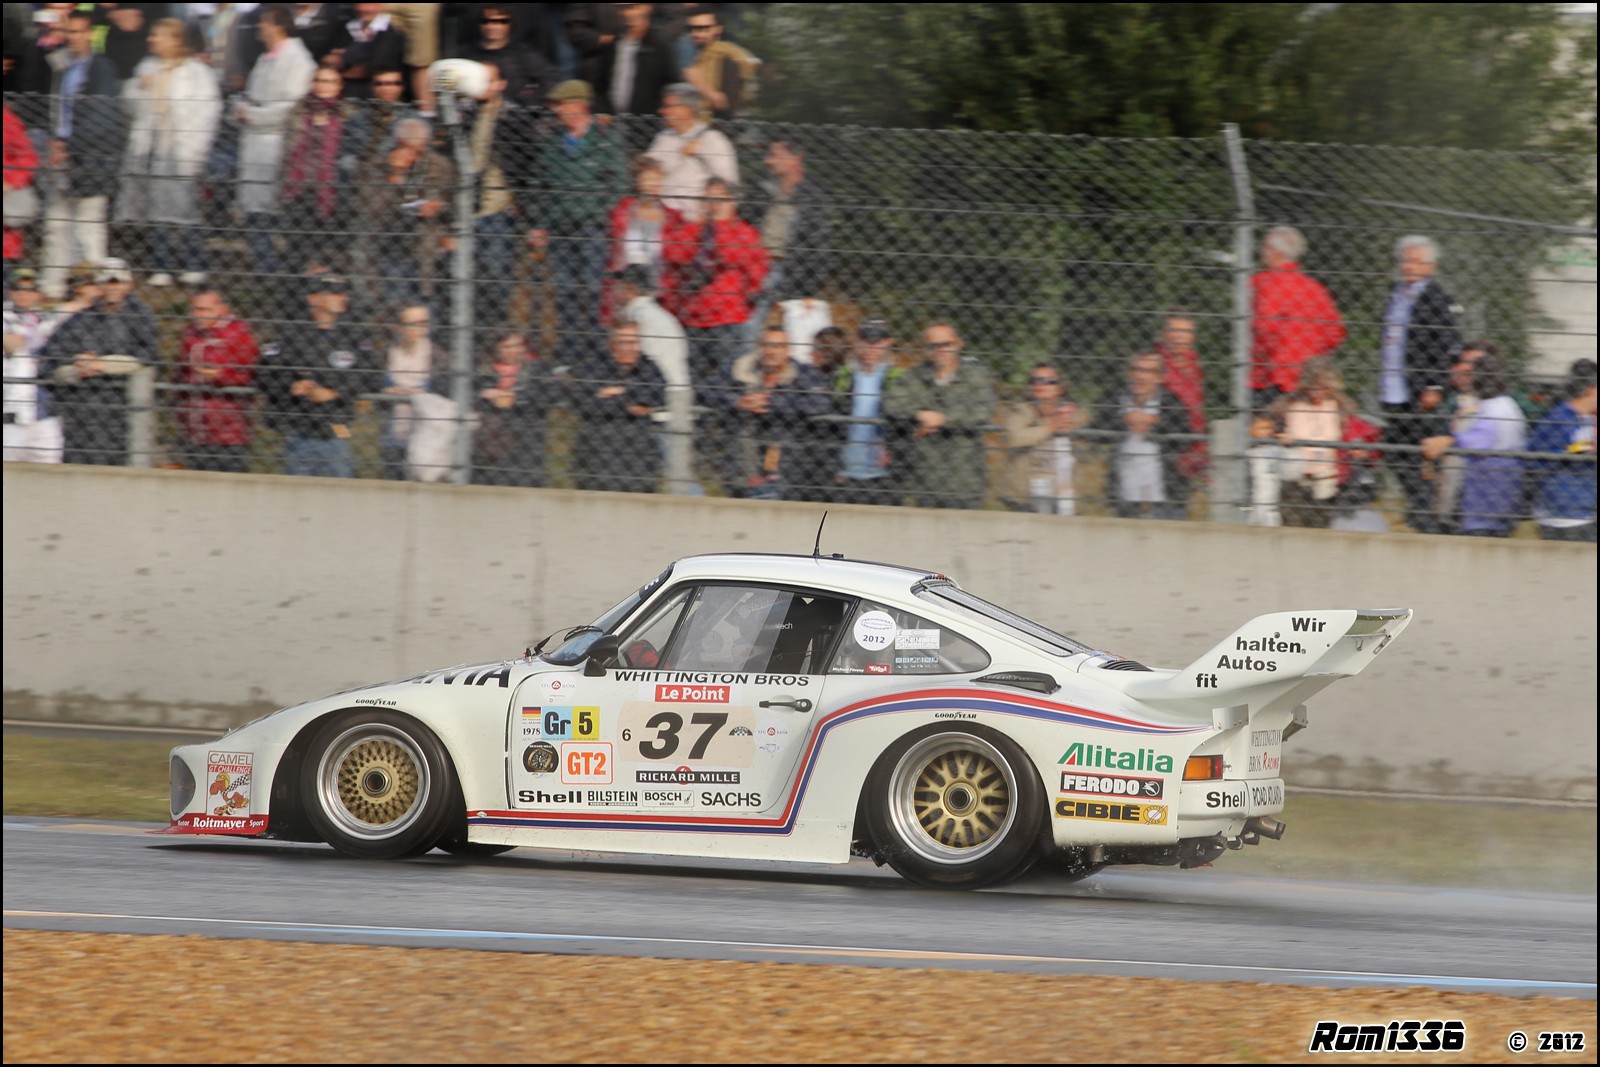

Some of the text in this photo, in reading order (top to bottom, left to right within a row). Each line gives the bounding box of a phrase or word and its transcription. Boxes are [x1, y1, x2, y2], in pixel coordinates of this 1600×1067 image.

[1291, 617, 1327, 632] Wir
[863, 634, 886, 643] 2012
[1236, 637, 1301, 653] halten
[1217, 655, 1278, 672] Autos
[614, 671, 810, 686] WHITTINGTON BROS
[1195, 673, 1218, 688] fit
[660, 687, 725, 701] Le Point
[355, 698, 397, 706] GOODYEAR
[934, 711, 977, 719] GOODYEAR
[544, 711, 593, 736] Gr 5
[522, 727, 541, 736] 1978
[621, 711, 729, 760] 6 37
[209, 753, 251, 766] CAMEL
[567, 752, 607, 776] GT2
[1057, 742, 1174, 773] Alitalia
[208, 764, 251, 775] GT CHALLENGE
[639, 772, 739, 783] RICHARD MILLE
[1063, 774, 1140, 796] FERODO
[518, 790, 582, 803] Shell
[587, 790, 638, 802] BILSTEIN
[644, 792, 682, 801] BOSCH
[701, 791, 761, 807] SACHS
[1206, 790, 1246, 809] Shell
[192, 816, 247, 830] Roitmayer
[249, 818, 265, 828] Sport
